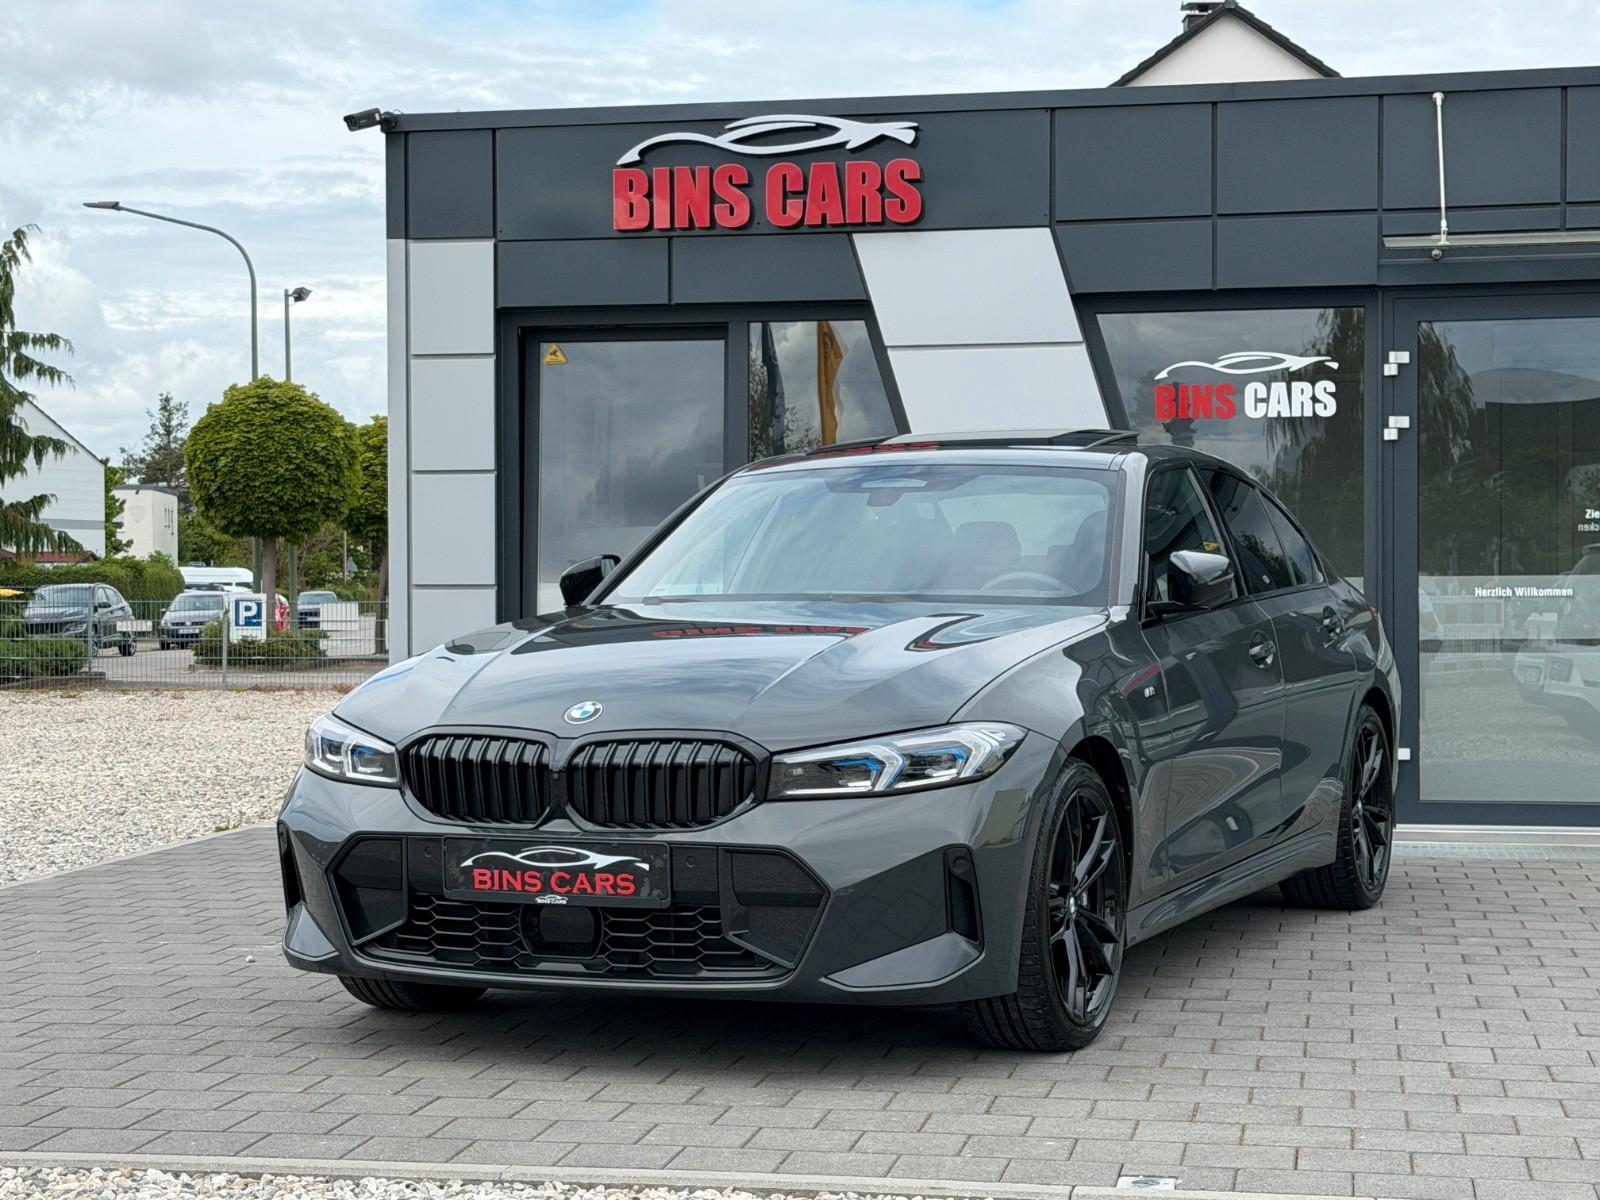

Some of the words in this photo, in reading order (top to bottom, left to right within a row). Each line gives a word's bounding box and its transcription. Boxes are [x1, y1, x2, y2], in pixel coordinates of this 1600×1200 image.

[613, 163, 751, 230] BINS
[766, 158, 922, 227] CARS
[1154, 382, 1237, 421] BINS
[1244, 380, 1337, 419] CARS
[1474, 586, 1513, 597] Herzlich
[1514, 586, 1574, 597] Willkommen
[238, 601, 258, 625] P
[473, 868, 542, 893] BINS
[550, 870, 636, 896] CARS
